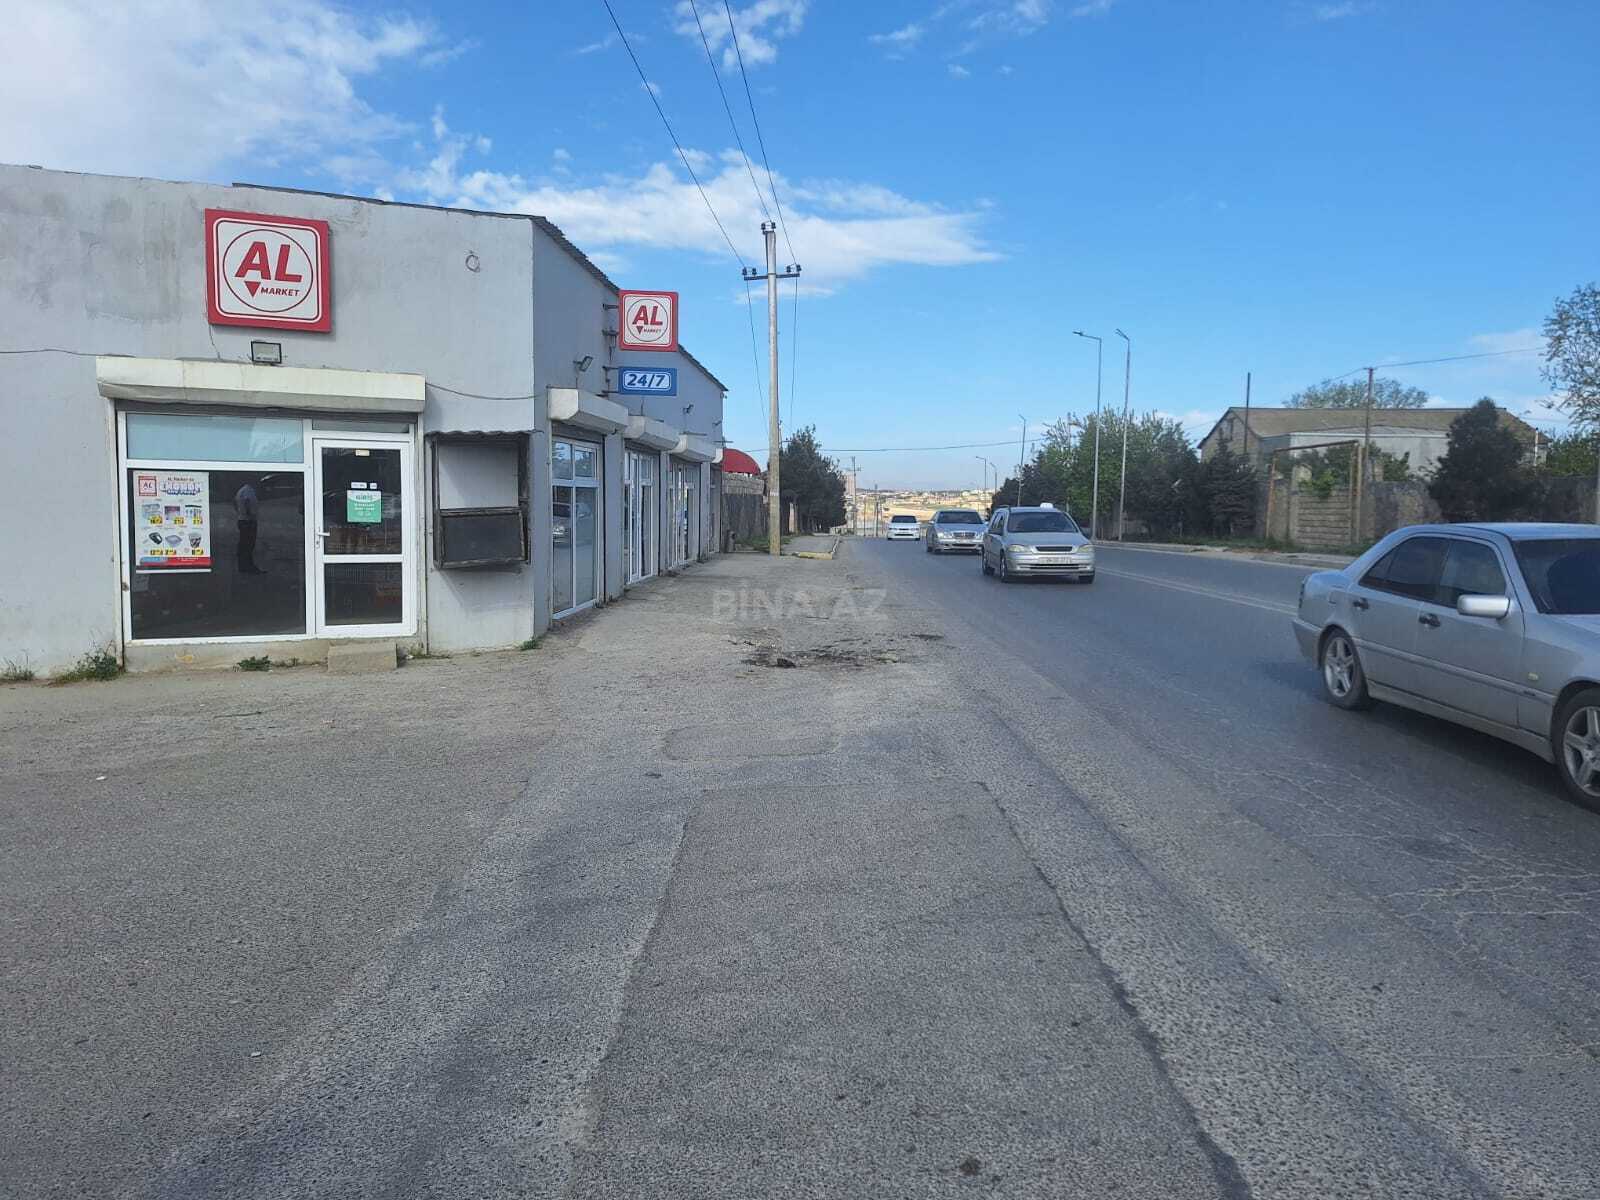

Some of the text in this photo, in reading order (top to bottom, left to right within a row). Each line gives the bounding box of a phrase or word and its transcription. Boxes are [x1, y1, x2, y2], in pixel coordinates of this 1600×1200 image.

[234, 241, 303, 283] AL
[260, 286, 300, 297] MARKET
[632, 304, 663, 326] AL
[626, 373, 666, 388] 24/7
